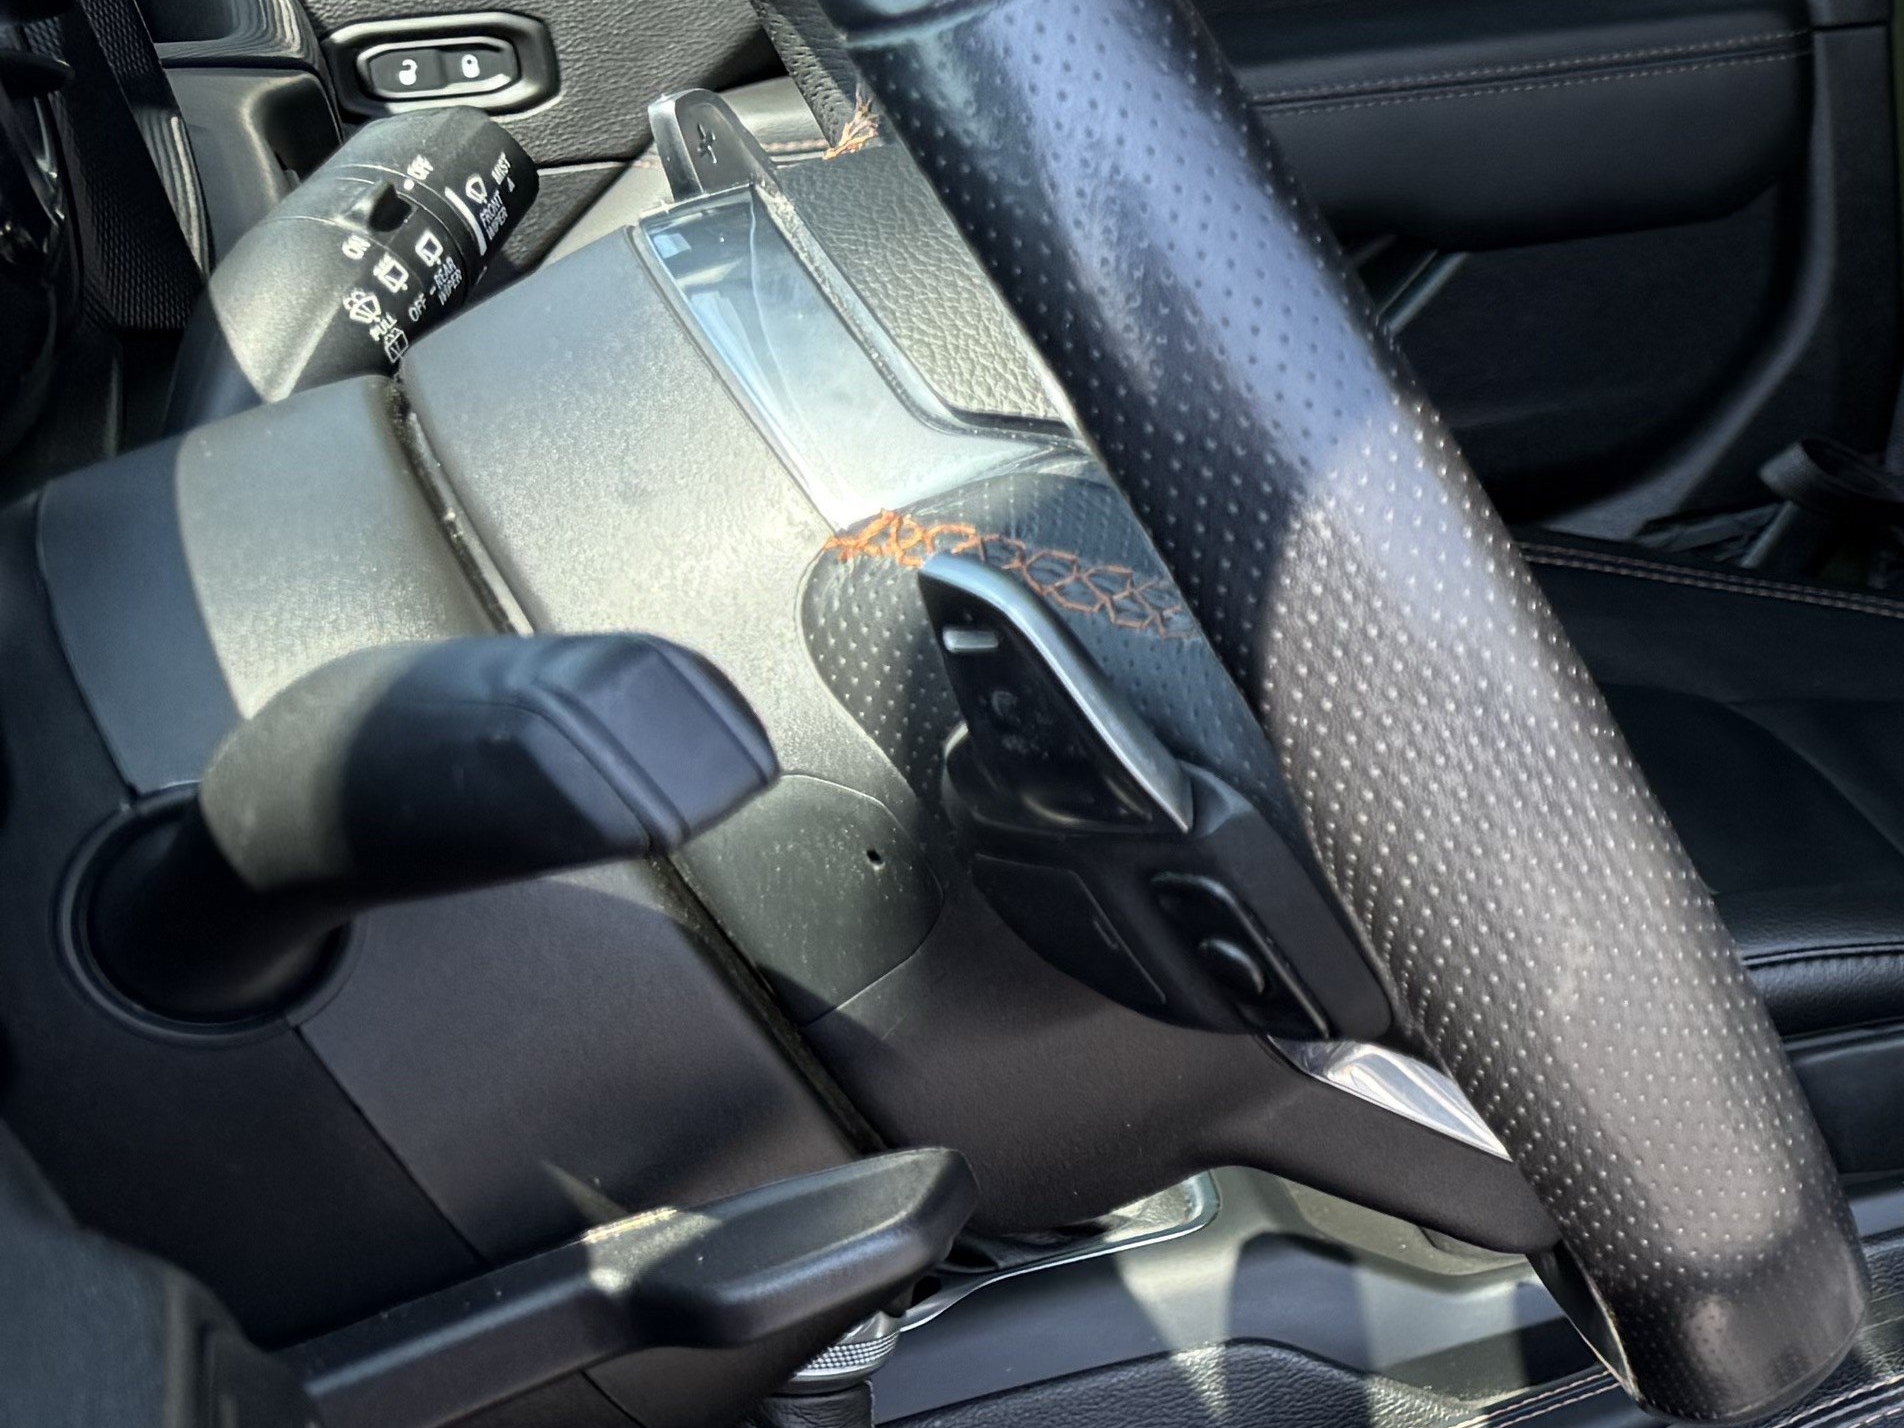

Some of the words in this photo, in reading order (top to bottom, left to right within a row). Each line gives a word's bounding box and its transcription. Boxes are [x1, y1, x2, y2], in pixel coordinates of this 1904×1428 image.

[491, 151, 511, 185] MIST
[479, 189, 503, 228] FRONT
[486, 206, 508, 241] WIPER
[433, 256, 458, 287] REAR
[438, 268, 463, 305] WIPER
[408, 292, 427, 322] OFF
[369, 312, 397, 342] PULL
